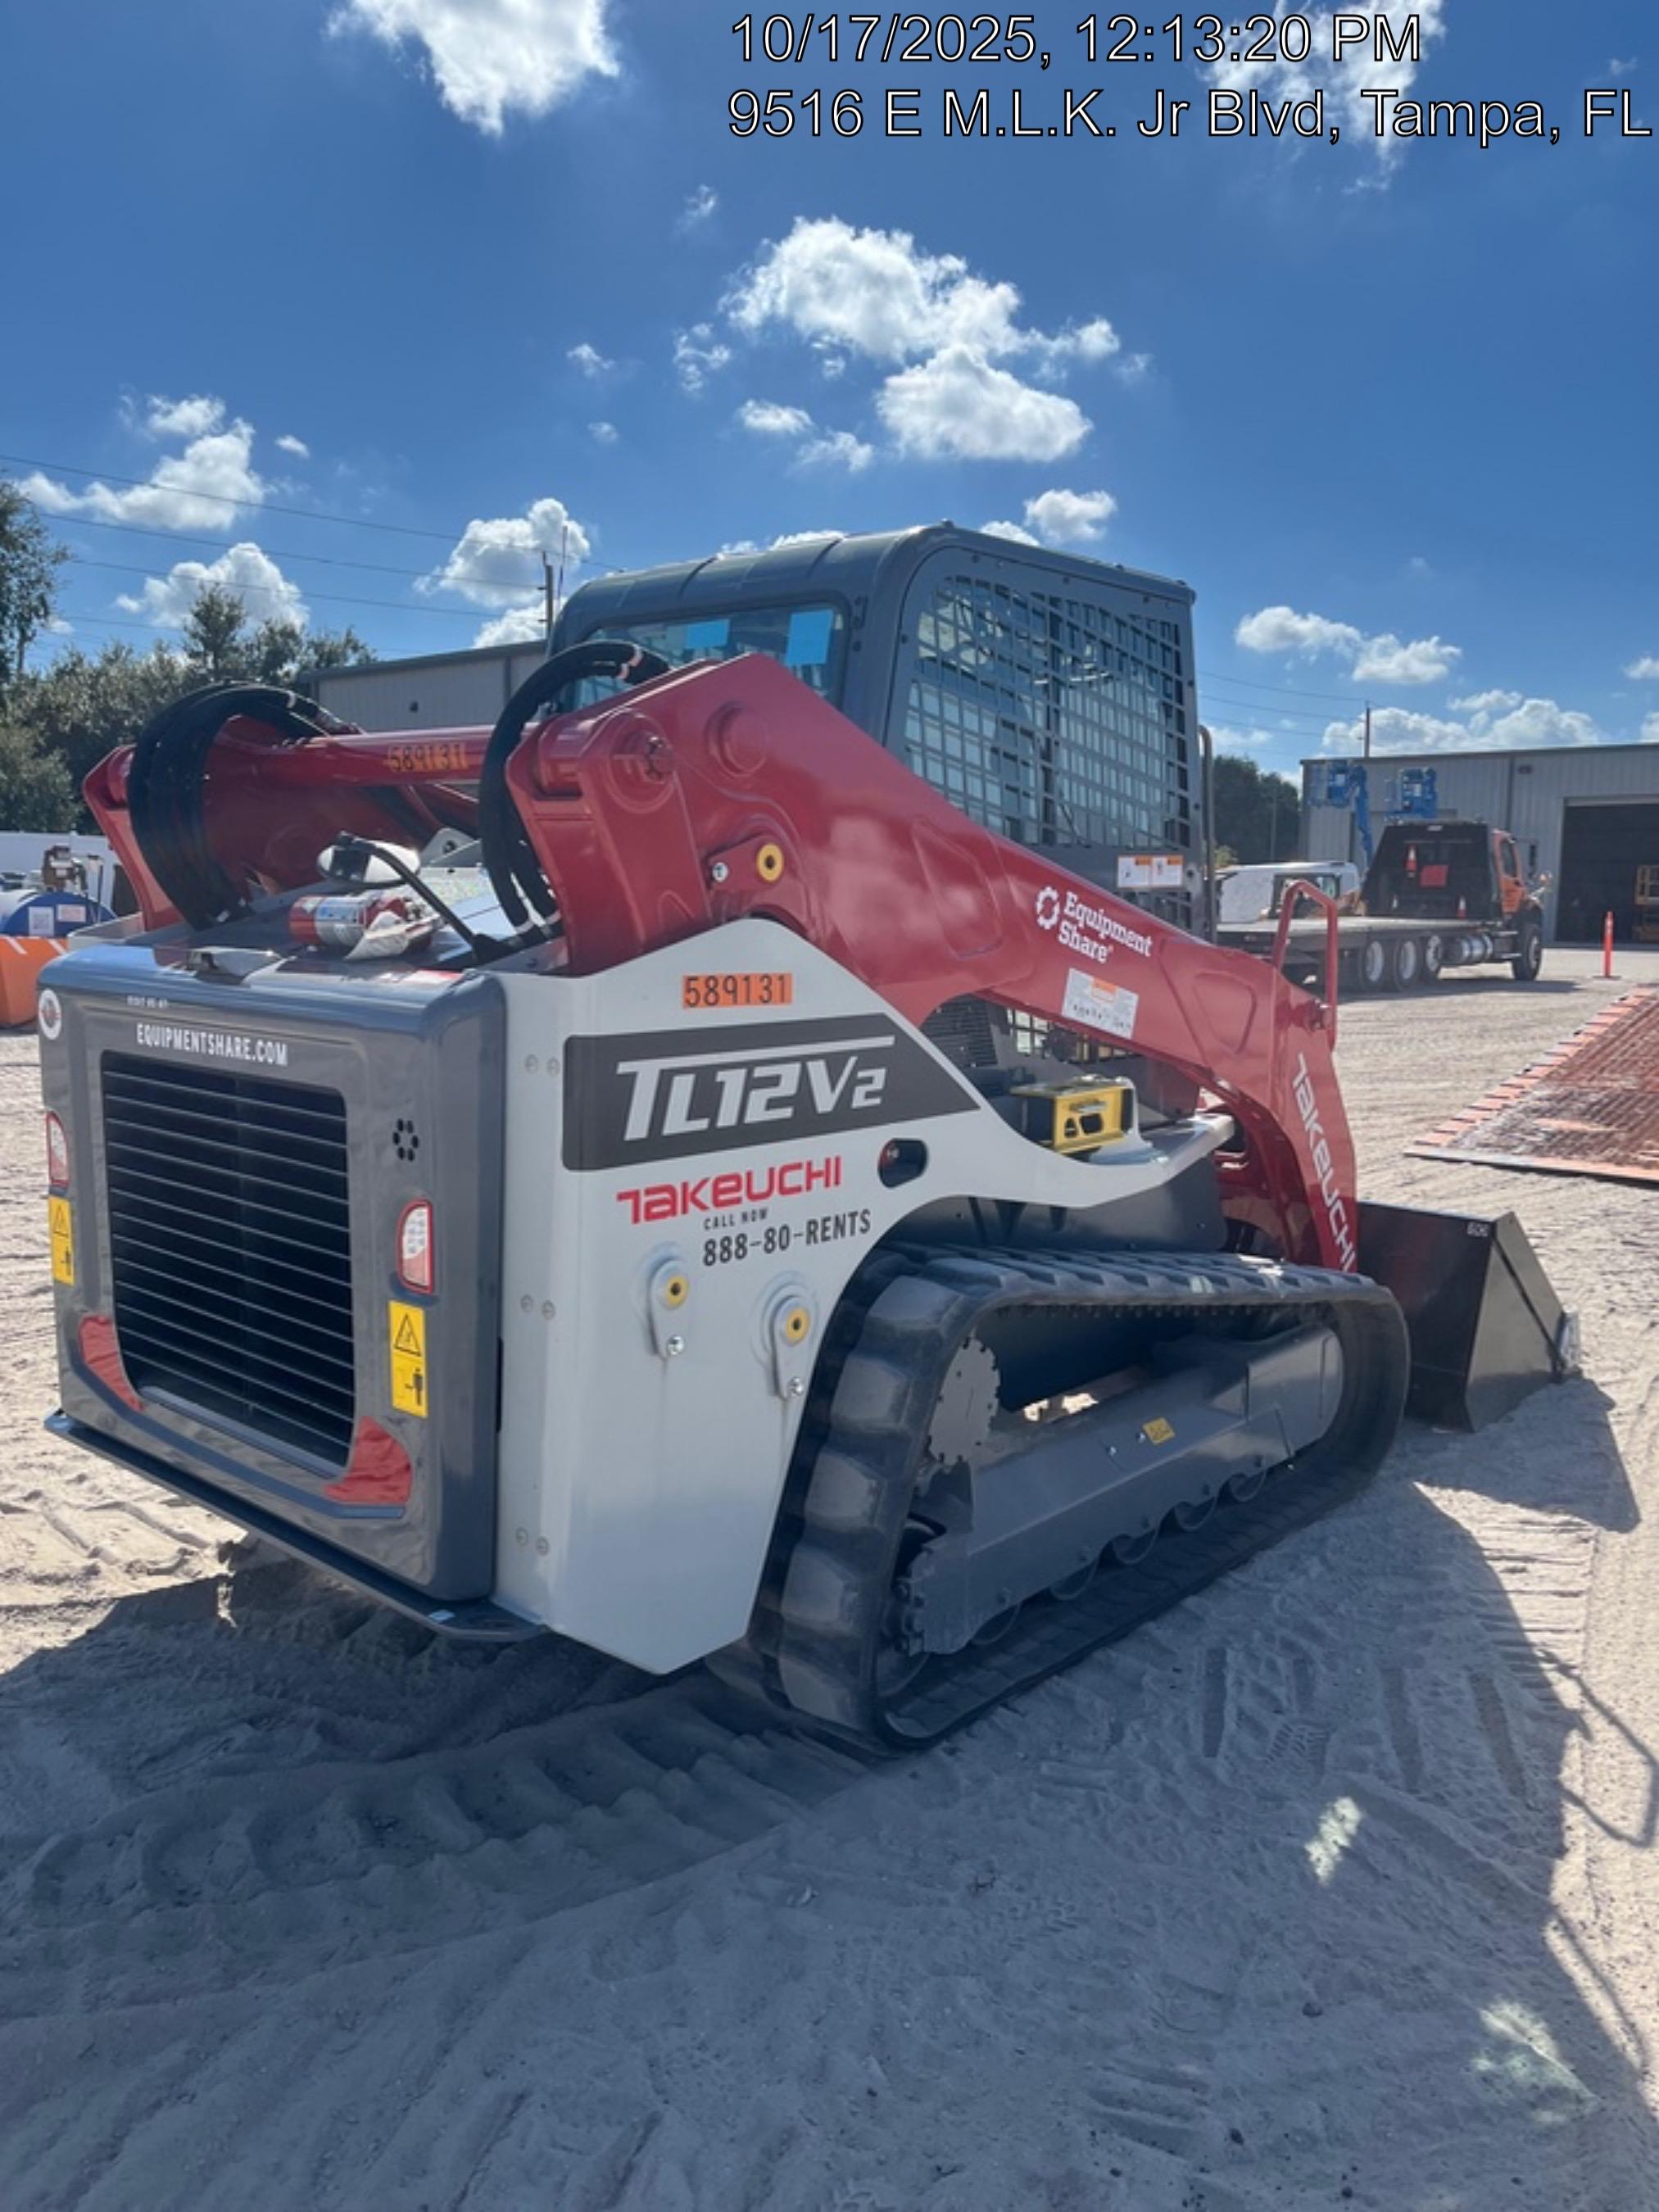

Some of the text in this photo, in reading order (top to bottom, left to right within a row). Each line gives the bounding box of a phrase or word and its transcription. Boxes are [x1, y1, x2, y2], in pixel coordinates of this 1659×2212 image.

[1063, 891, 1153, 957] Equipment
[685, 973, 786, 1009] 589131
[135, 1022, 288, 1066] EQUIPMENTSHARE.COM
[616, 1035, 895, 1141] TL12V2
[616, 1155, 842, 1226] TAKEUCHI
[703, 1208, 768, 1231] CALL NOW
[702, 1208, 872, 1267] 888-80-RENTS
